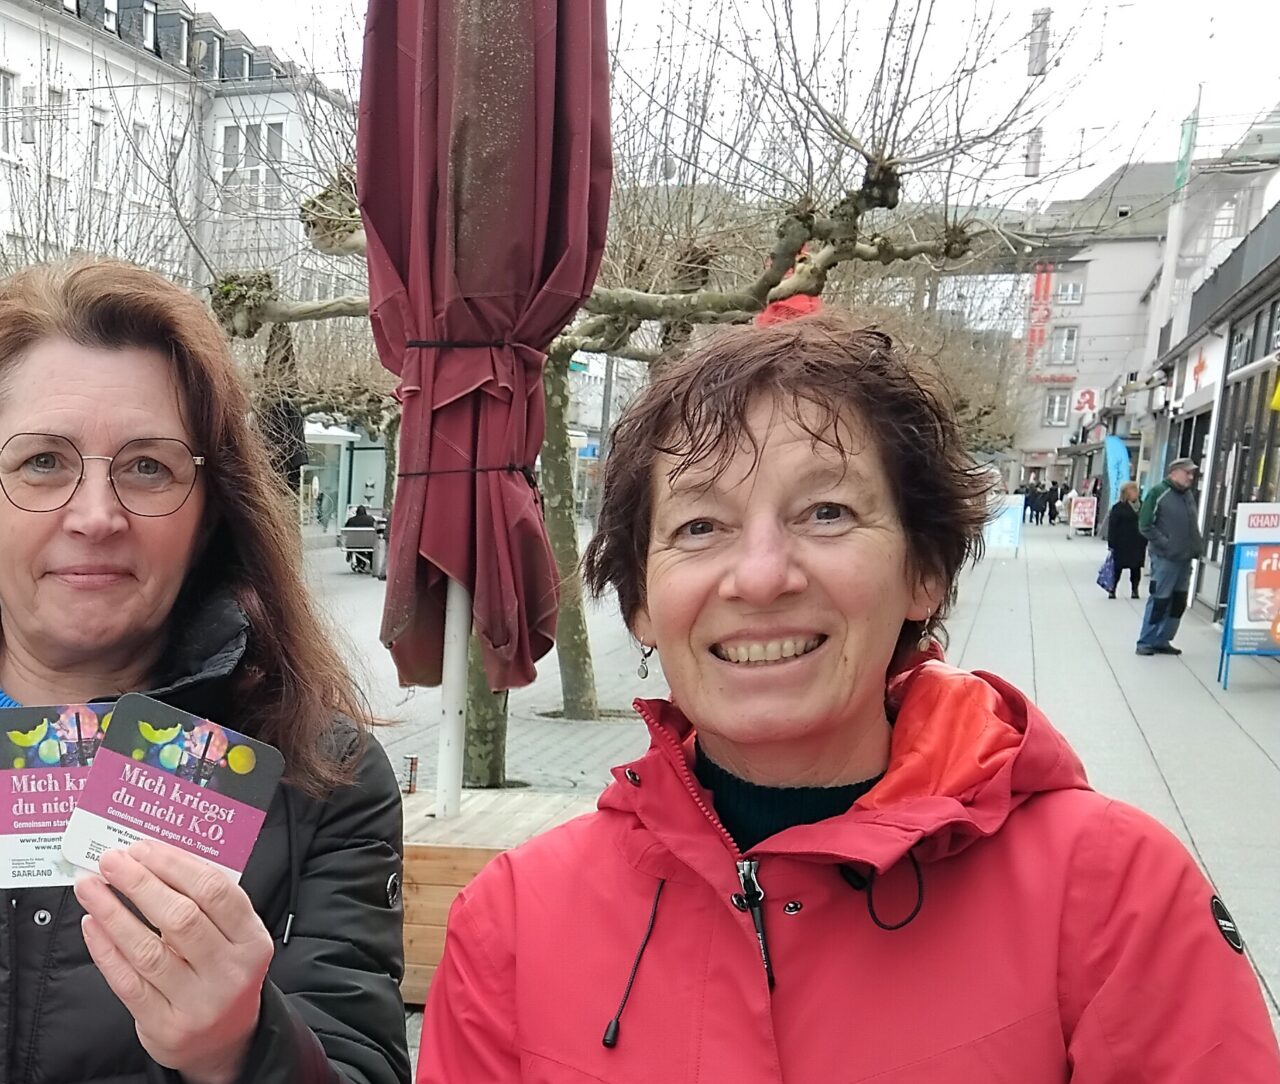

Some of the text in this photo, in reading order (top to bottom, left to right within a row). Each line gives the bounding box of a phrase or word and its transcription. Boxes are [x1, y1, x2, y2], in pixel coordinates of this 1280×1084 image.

[11, 773, 61, 793] Mich
[119, 763, 166, 797] Mich
[169, 783, 236, 823] kriegst
[12, 795, 78, 816] du nich
[112, 787, 225, 845] du nicht K.O.
[13, 820, 52, 829] Gemeinsam
[107, 806, 144, 827] Gemeinsam
[143, 821, 161, 833] stark
[161, 828, 181, 841] gegen
[11, 869, 53, 878] SAARLAND
